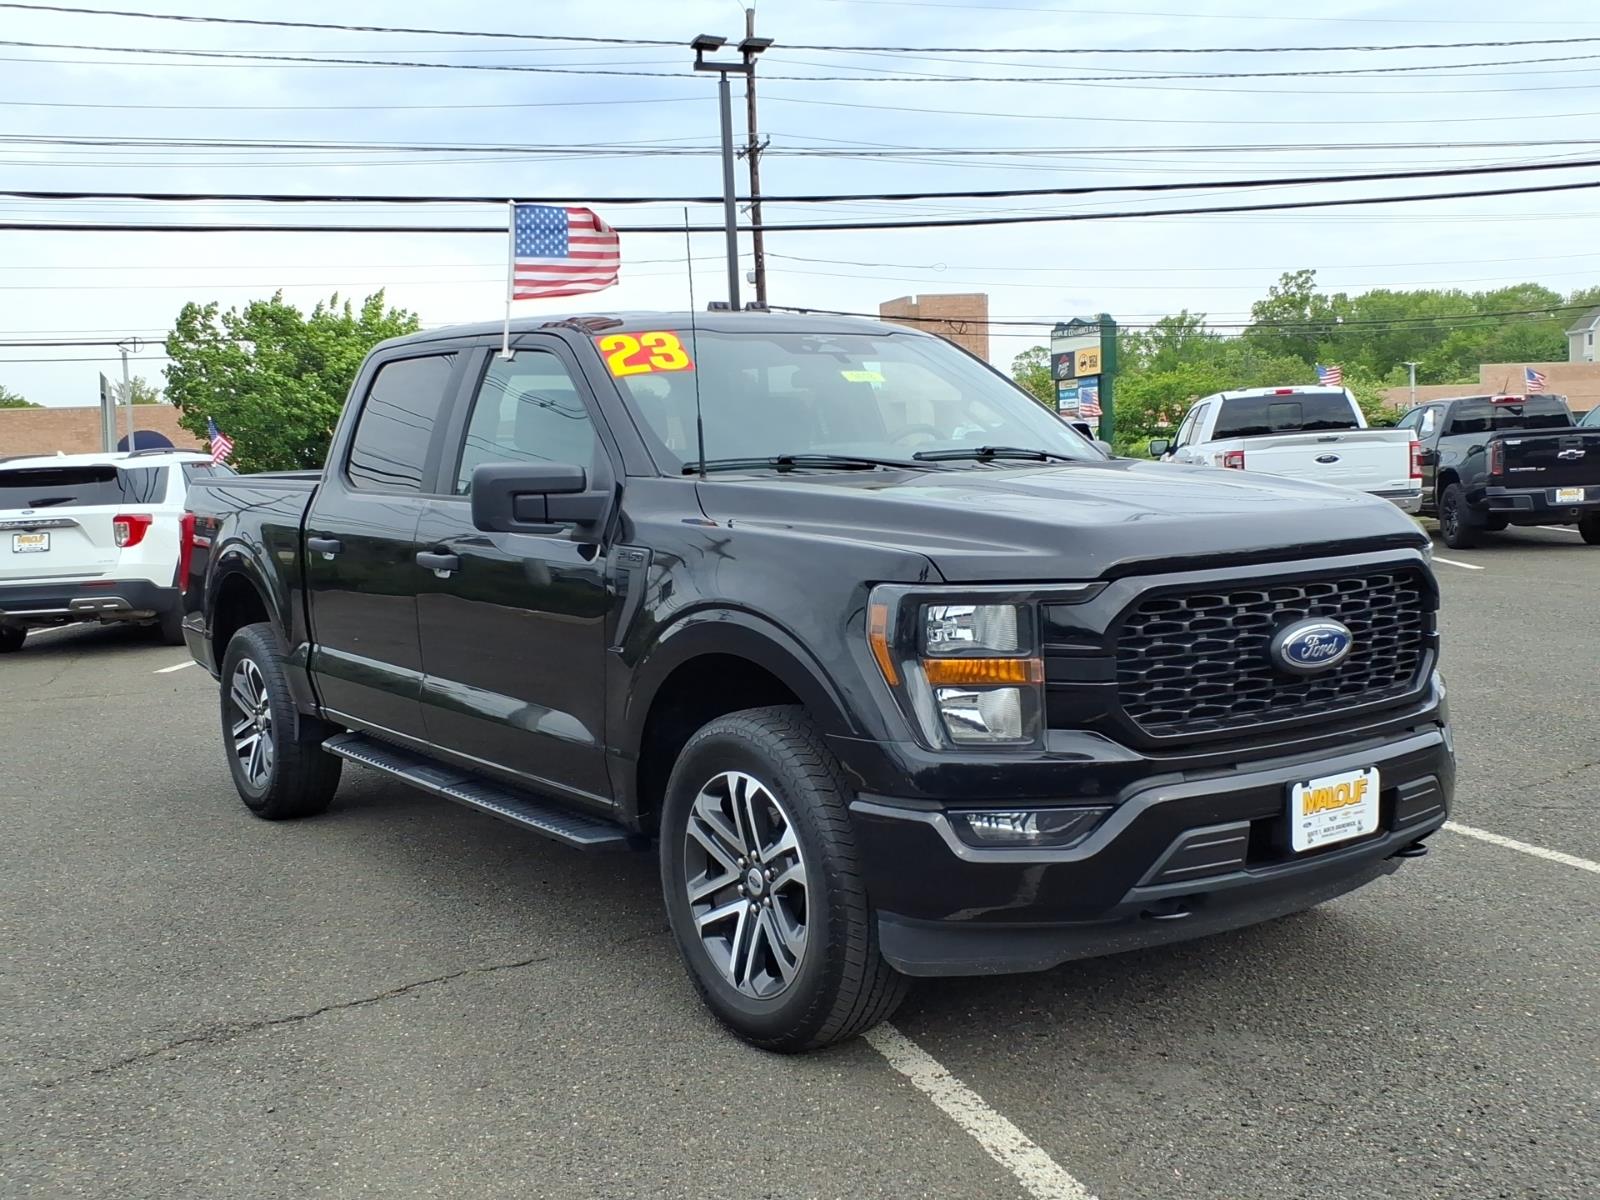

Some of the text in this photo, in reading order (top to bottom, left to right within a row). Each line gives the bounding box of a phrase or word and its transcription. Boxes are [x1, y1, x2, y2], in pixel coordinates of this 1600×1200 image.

[600, 331, 689, 377] 23
[1301, 633, 1339, 659] Ford
[1303, 778, 1368, 816] MALOUF
